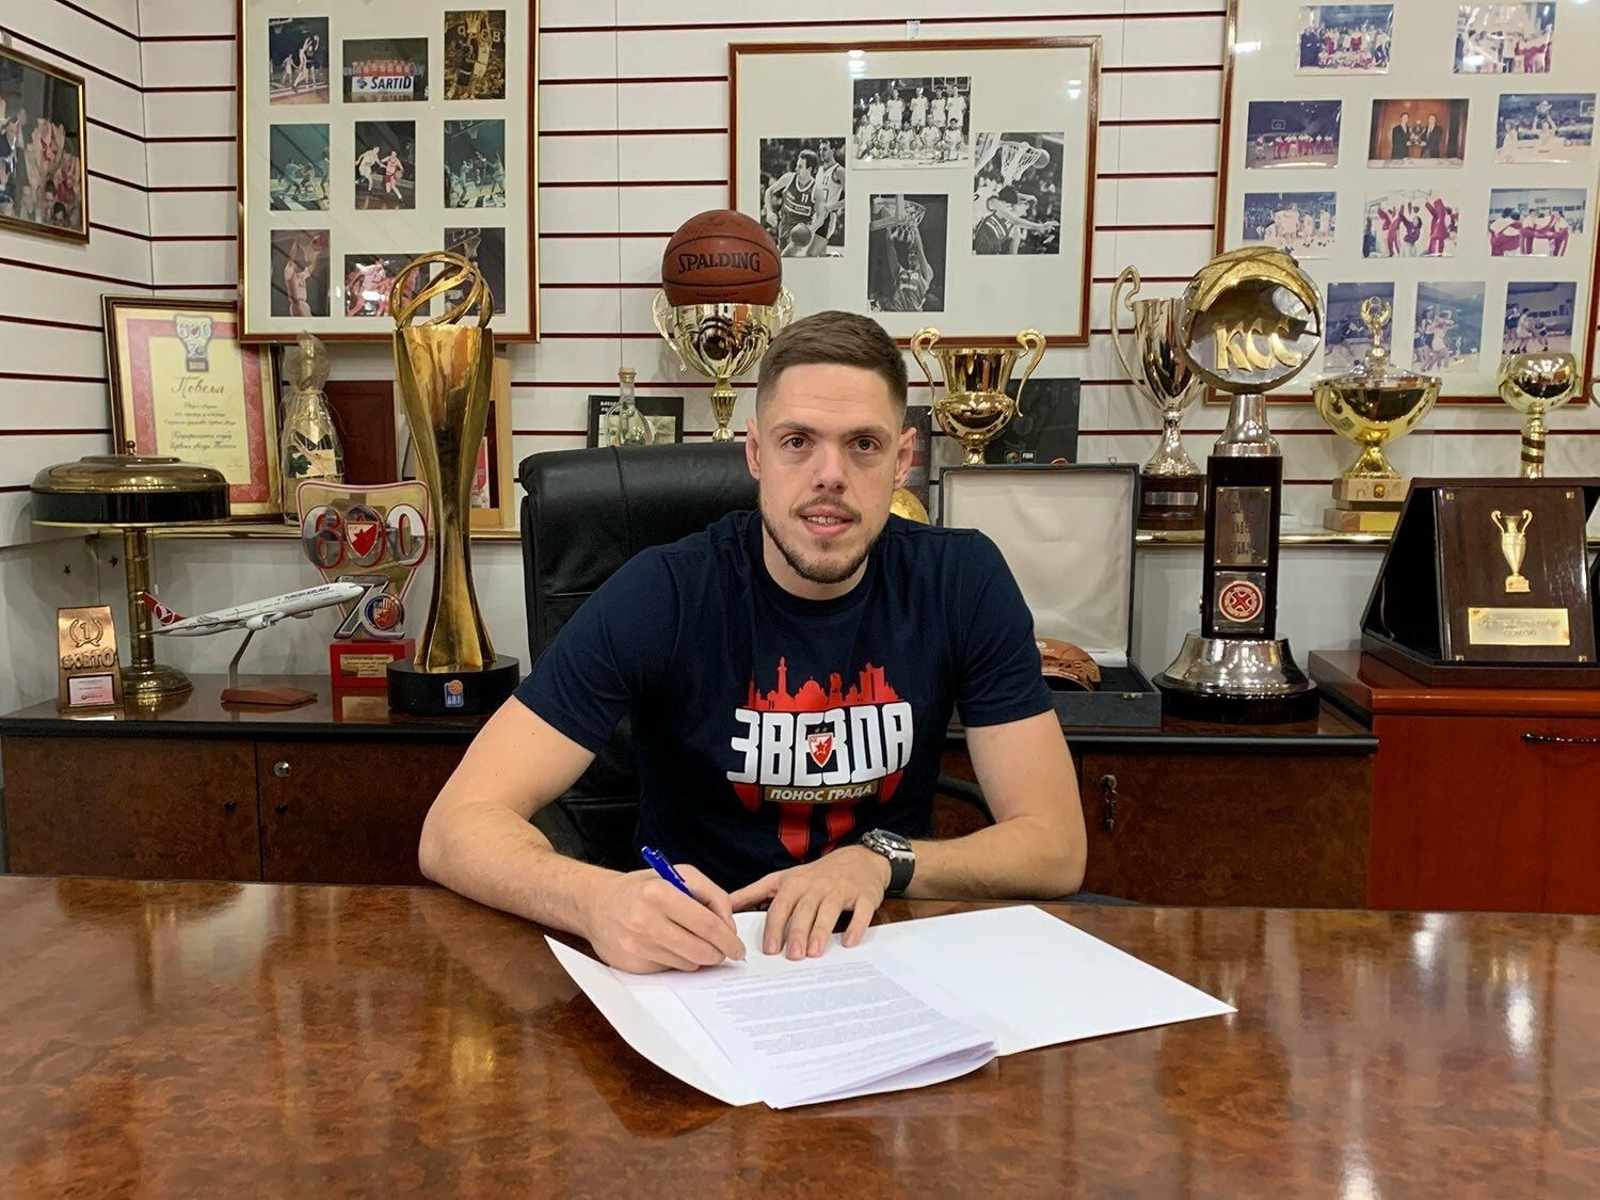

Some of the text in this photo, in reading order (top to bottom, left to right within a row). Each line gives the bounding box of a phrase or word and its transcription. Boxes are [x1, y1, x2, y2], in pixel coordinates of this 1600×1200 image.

[370, 75, 412, 90] SARTID
[678, 252, 760, 274] SPALDING
[726, 701, 914, 787] ЗВЕЗДА
[769, 784, 872, 801] ПОНОС ГРАДА
